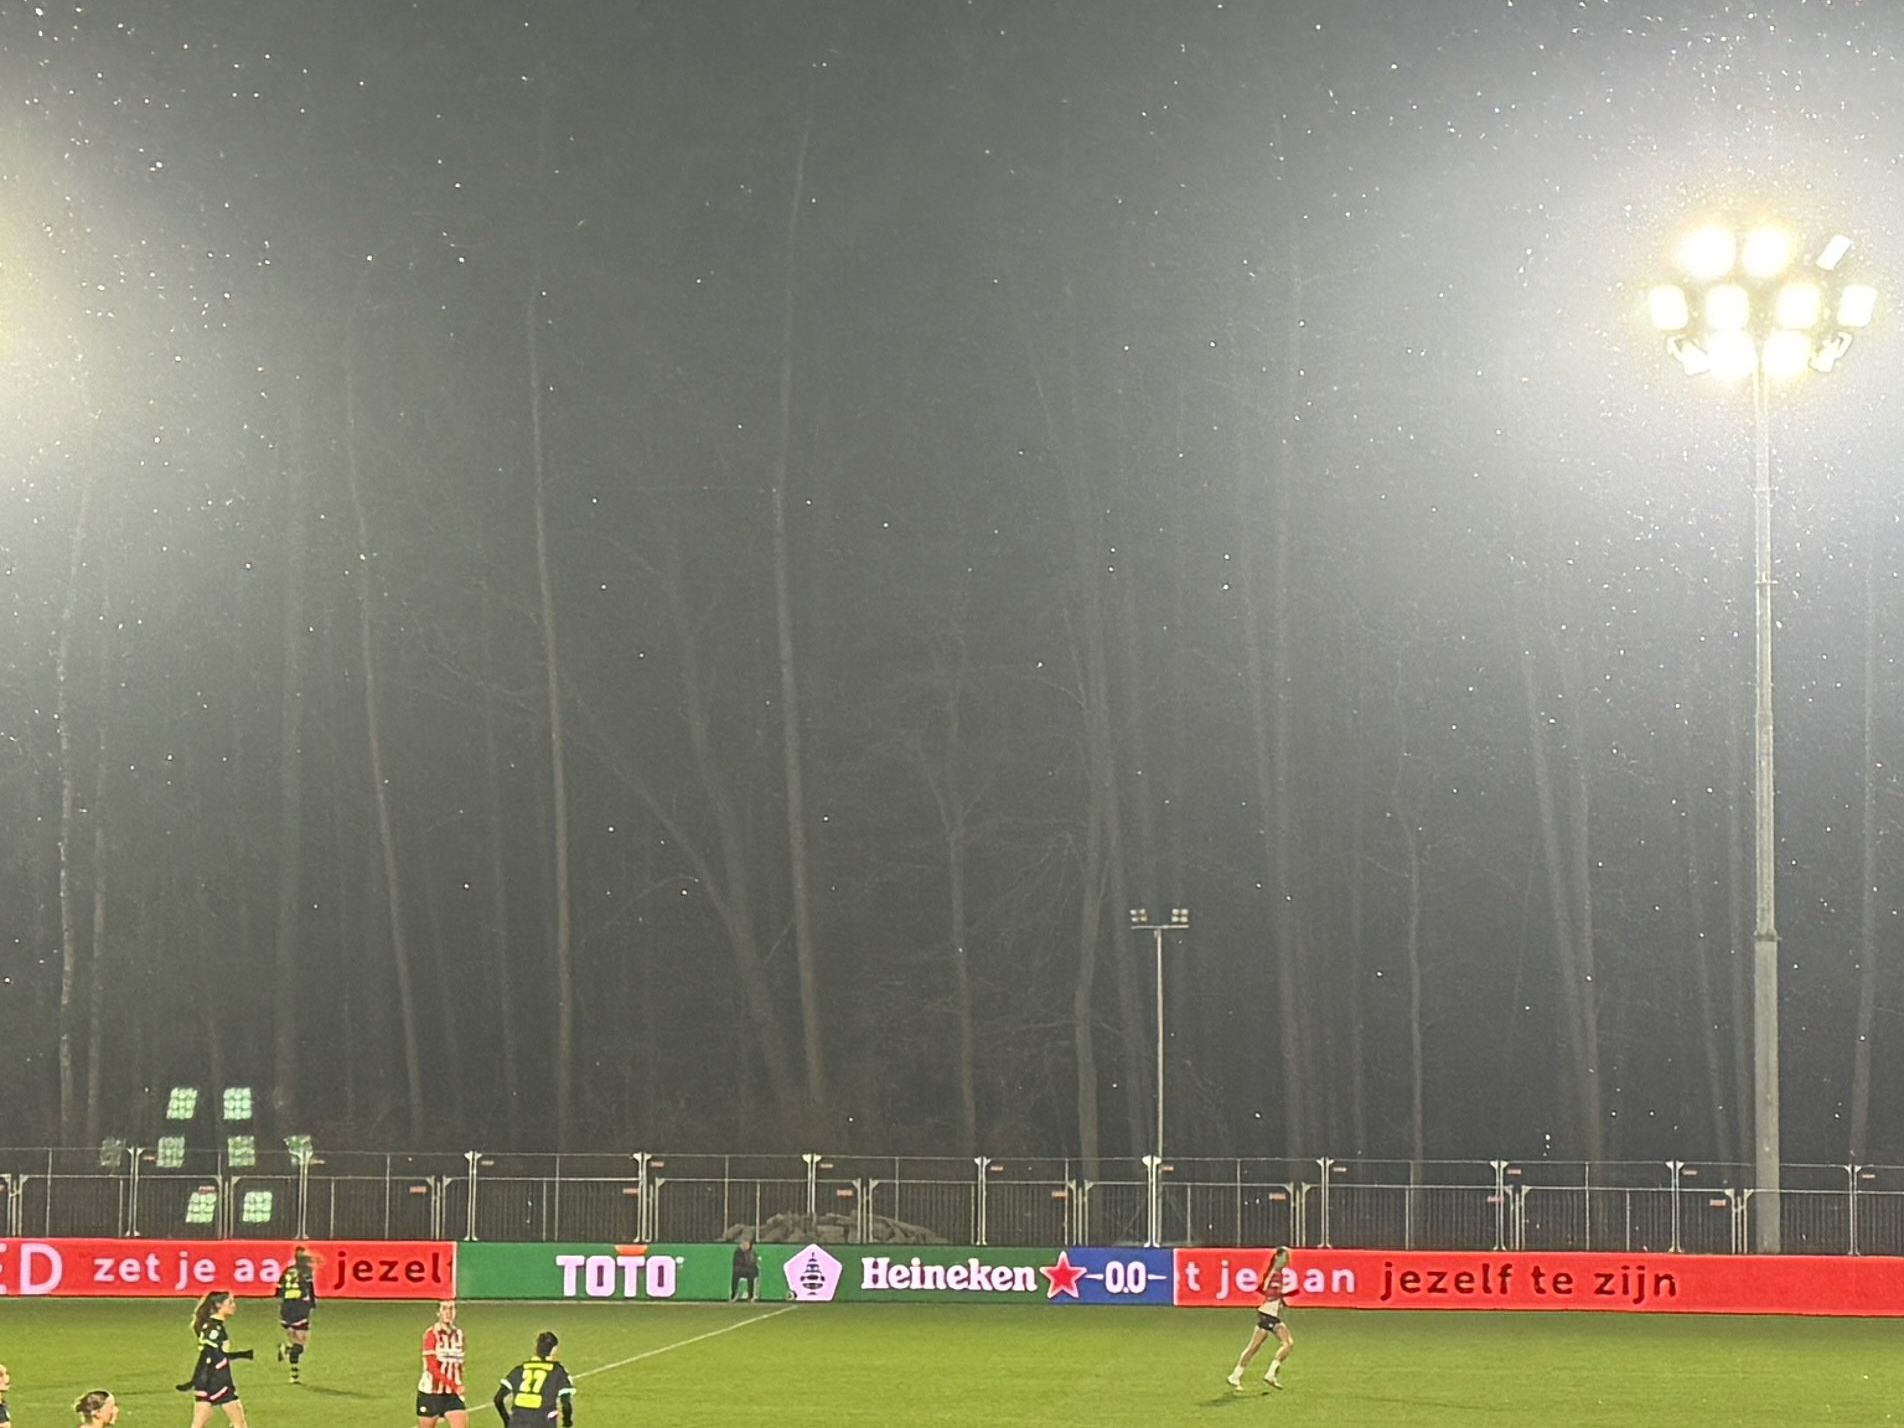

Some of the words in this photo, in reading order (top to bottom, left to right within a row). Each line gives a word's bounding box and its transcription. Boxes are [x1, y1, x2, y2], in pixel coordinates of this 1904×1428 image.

[94, 1253, 160, 1282] zet
[175, 1251, 216, 1290] je
[234, 1257, 295, 1283] aa
[333, 1251, 453, 1290] jezel
[556, 1255, 676, 1298] TOTO
[861, 1256, 1037, 1292] Heineken
[1216, 1259, 1259, 1300] je
[1380, 1261, 1513, 1302] jezelf
[1531, 1265, 1574, 1295] te
[1594, 1265, 1677, 1305] zijn
